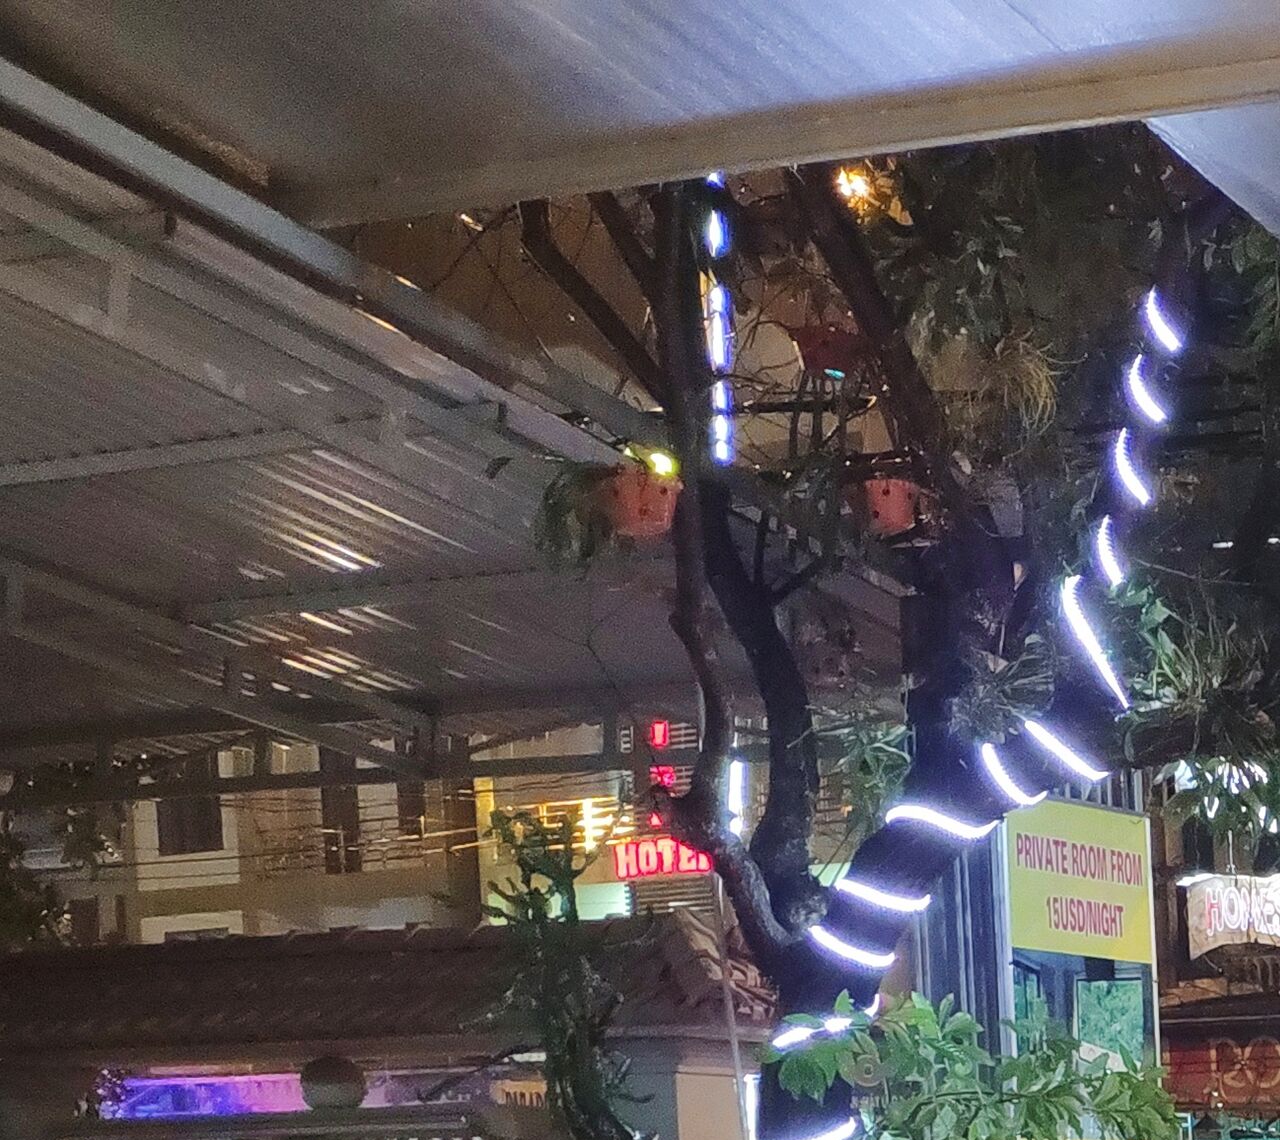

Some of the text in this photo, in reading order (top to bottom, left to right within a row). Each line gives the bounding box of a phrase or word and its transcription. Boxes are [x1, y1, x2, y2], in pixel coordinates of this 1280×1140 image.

[1016, 832, 1143, 887] PRIVATE ROOM FROM
[1046, 896, 1124, 938] 15USD/NIGHT
